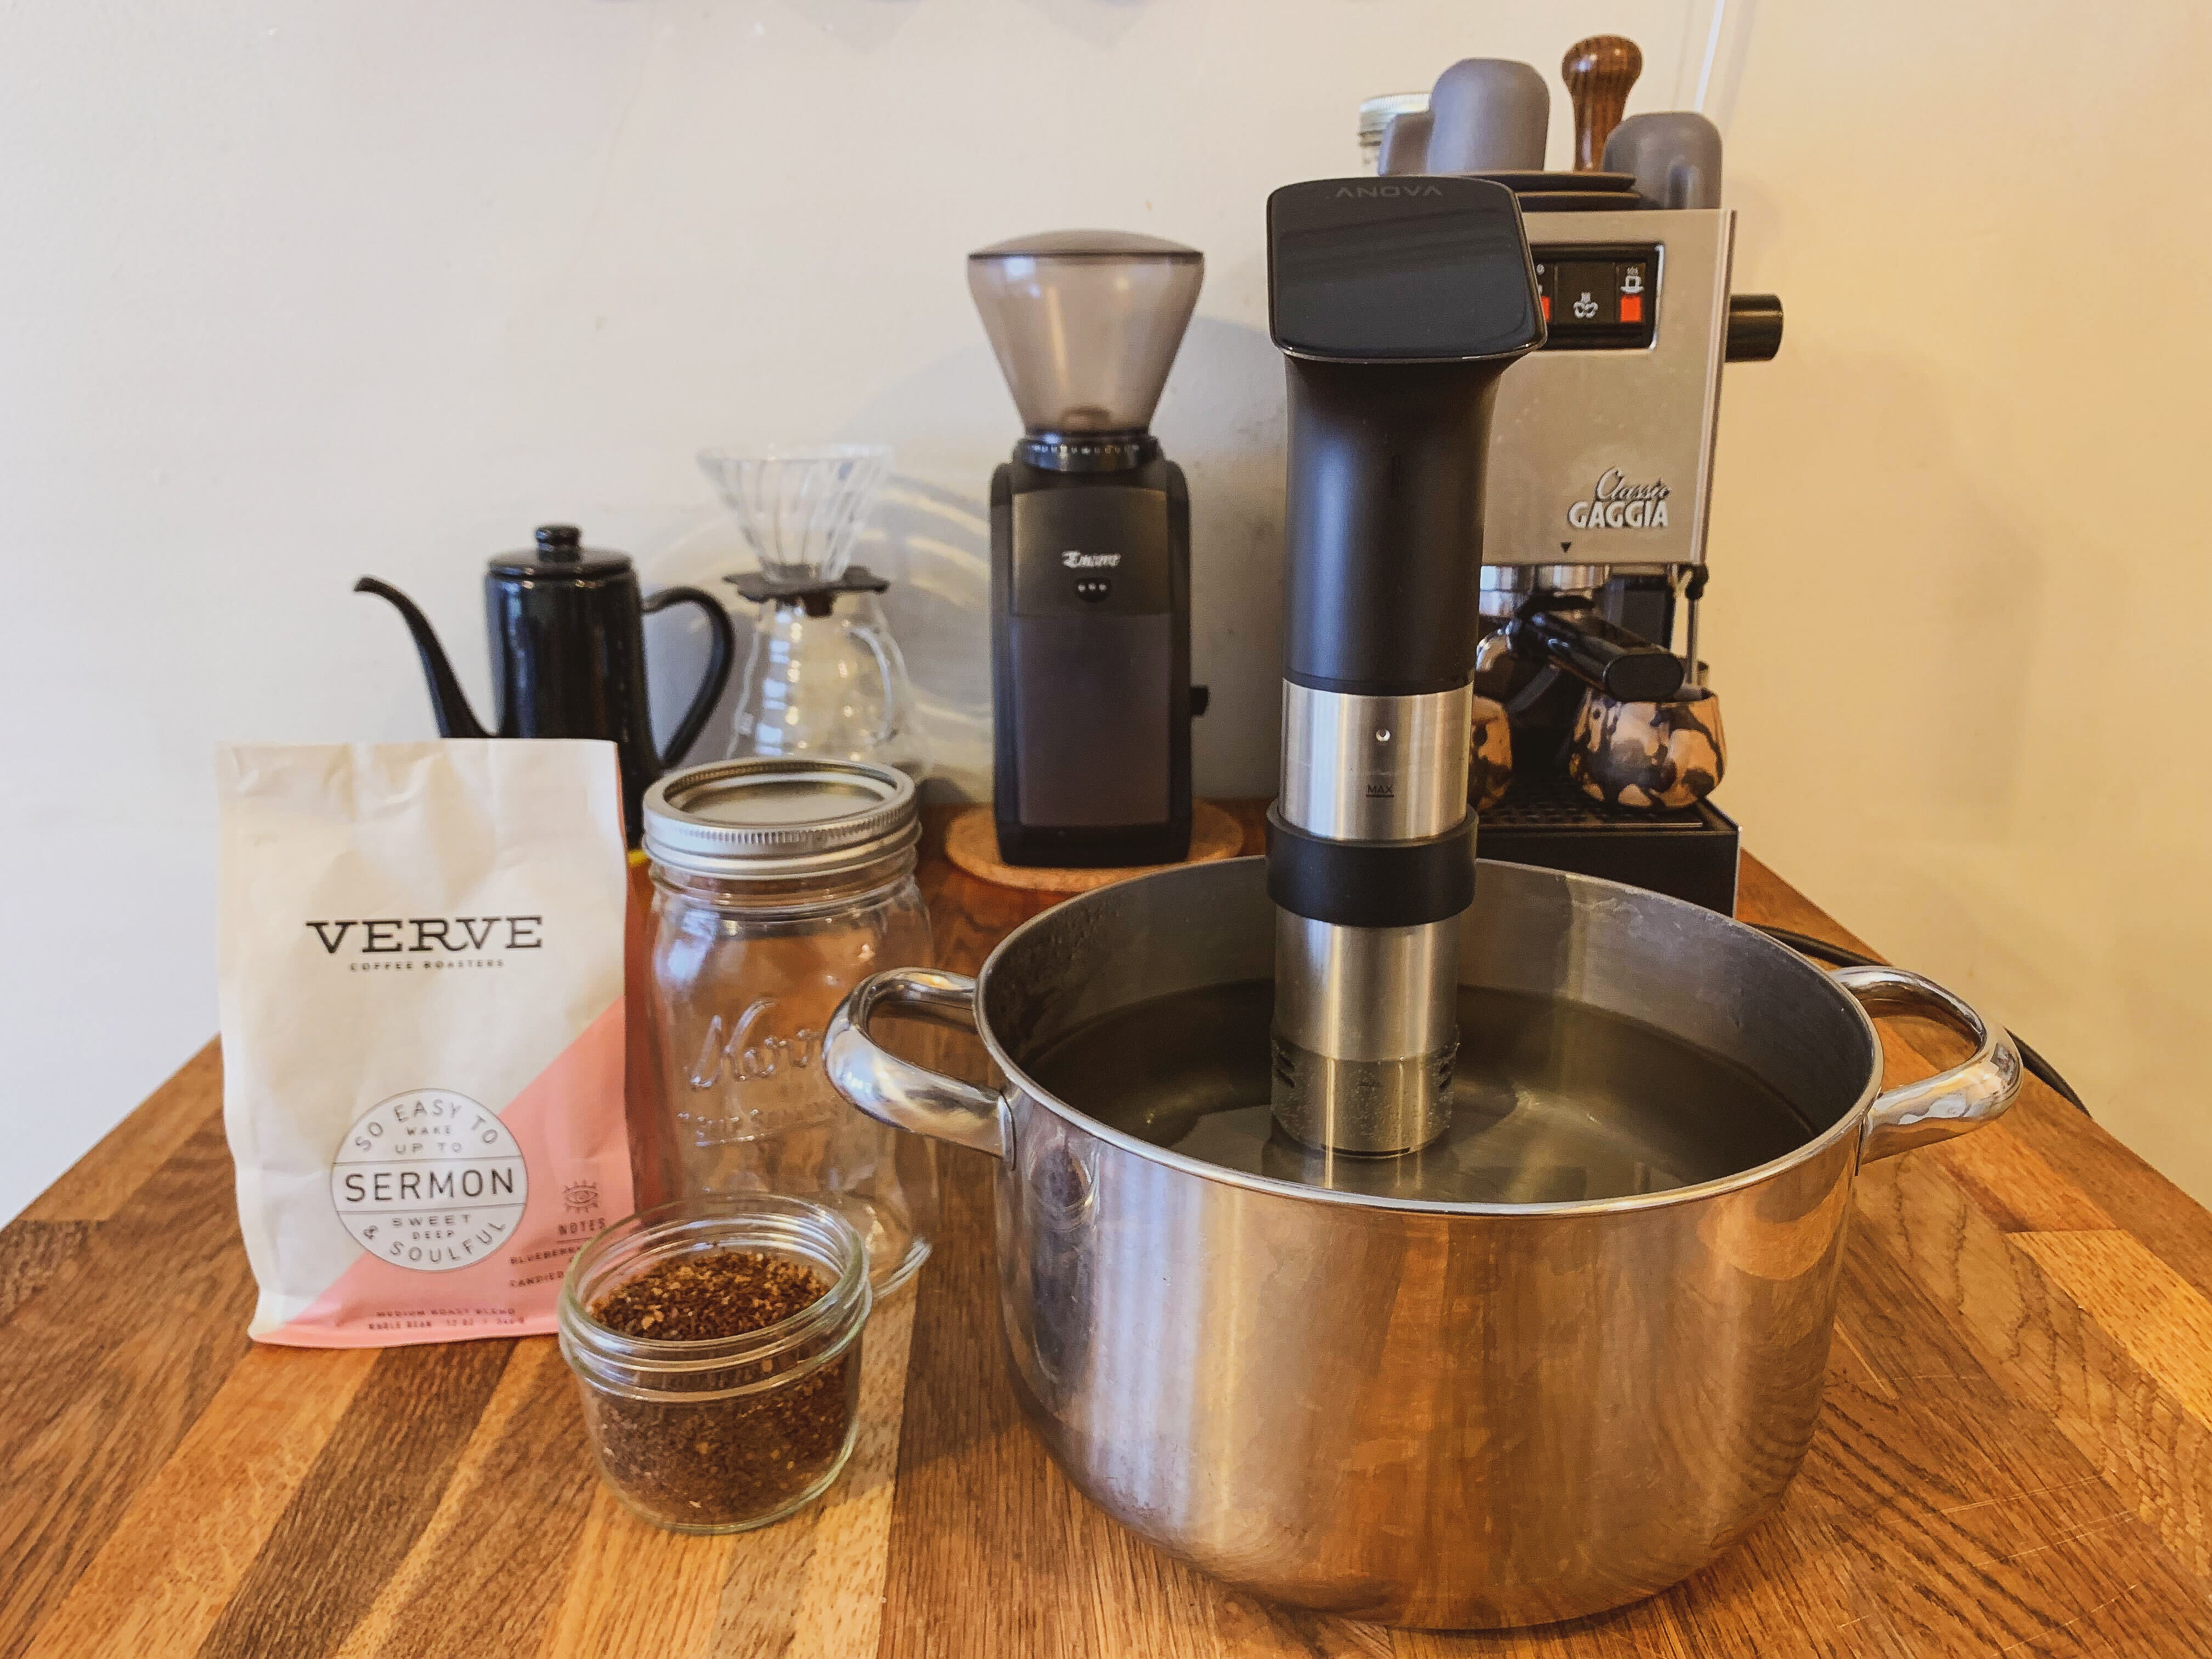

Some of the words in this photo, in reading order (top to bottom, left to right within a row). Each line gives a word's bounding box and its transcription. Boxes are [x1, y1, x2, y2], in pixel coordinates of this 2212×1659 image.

[1335, 184, 1443, 198] ANOVA
[1567, 500, 1668, 528] GAGGIA
[1368, 785, 1393, 794] MAX
[305, 916, 543, 954] VERVE
[349, 961, 413, 972] COFFEE
[424, 959, 504, 970] ROASTERS
[354, 1121, 383, 1153] SO
[393, 1099, 462, 1122] EASY
[471, 1115, 498, 1144] TO
[407, 1125, 452, 1136] WAKE
[395, 1143, 423, 1155] UP
[437, 1142, 462, 1153] TO
[345, 1167, 513, 1202] SERMON
[391, 1214, 471, 1228] SWEET
[558, 1217, 605, 1234] NOTES
[413, 1229, 455, 1240] DEEP
[363, 1225, 379, 1240] &
[390, 1222, 505, 1263] SOULFUL
[407, 1320, 432, 1328] BEAN
